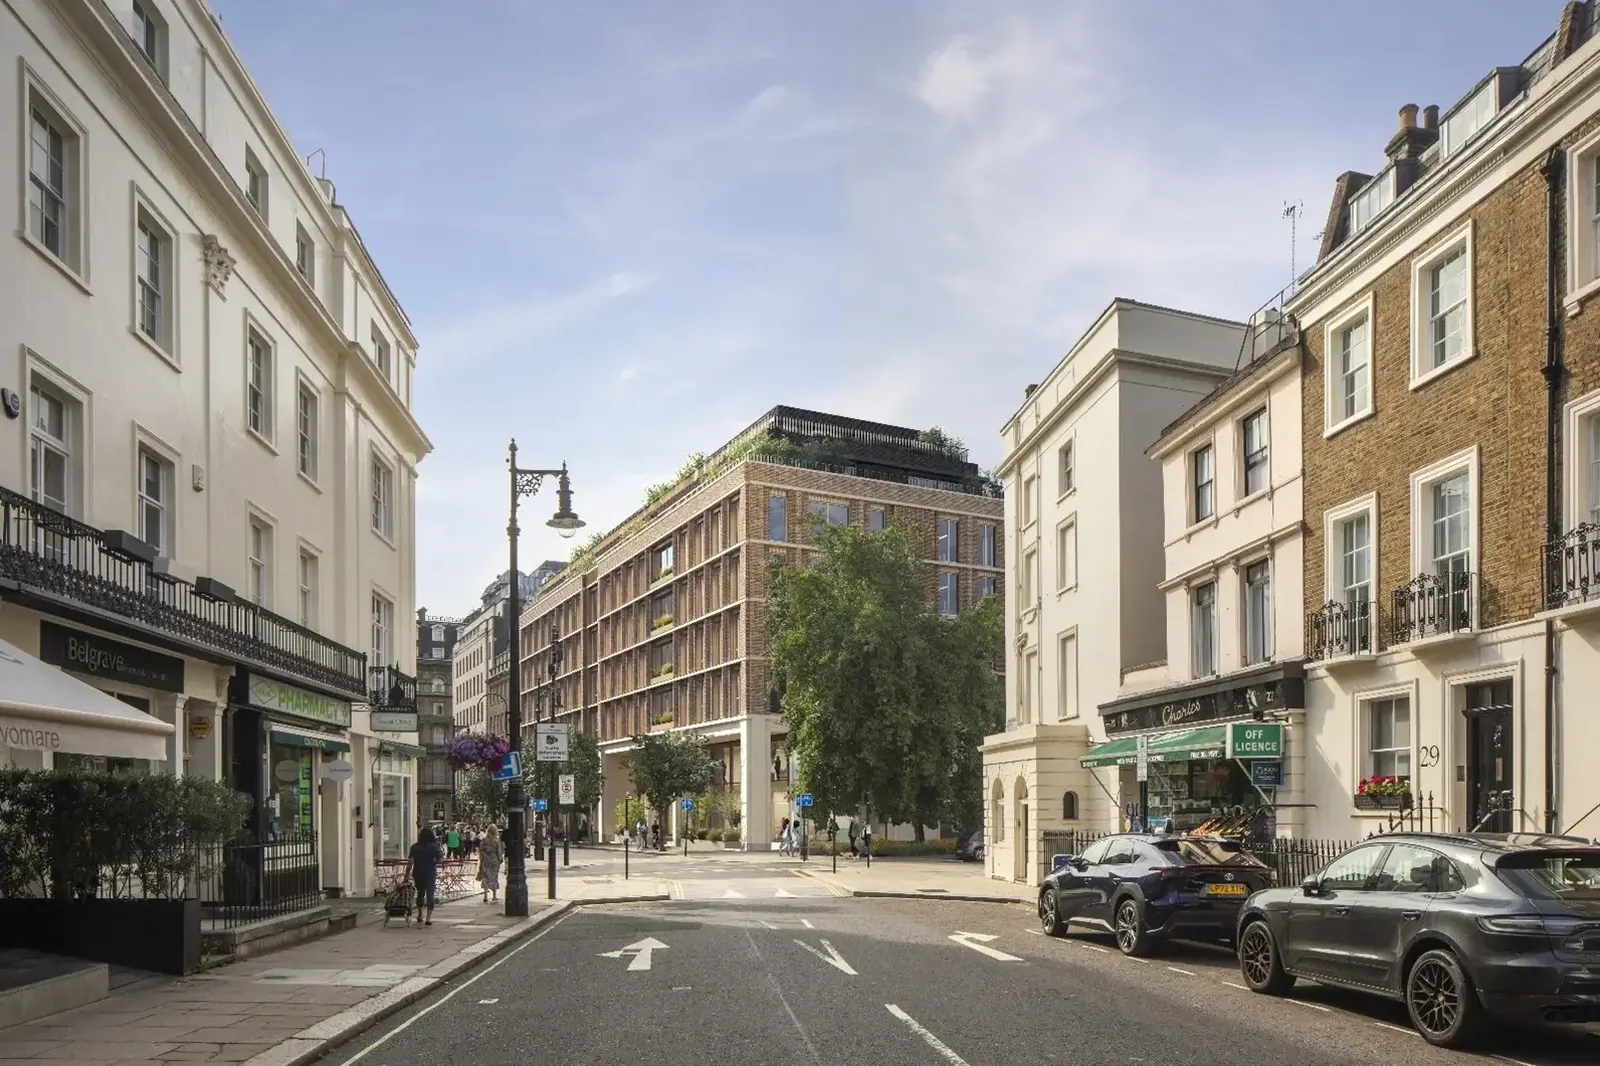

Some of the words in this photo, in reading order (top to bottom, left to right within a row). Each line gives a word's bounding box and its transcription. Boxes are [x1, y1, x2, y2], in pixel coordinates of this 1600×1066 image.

[68, 637, 124, 672] Belgrave
[278, 685, 339, 721] PHARMACY
[1162, 701, 1200, 726] Charles
[1245, 729, 1264, 740] OFF
[1235, 742, 1278, 752] LICENCE
[1420, 745, 1440, 767] 29
